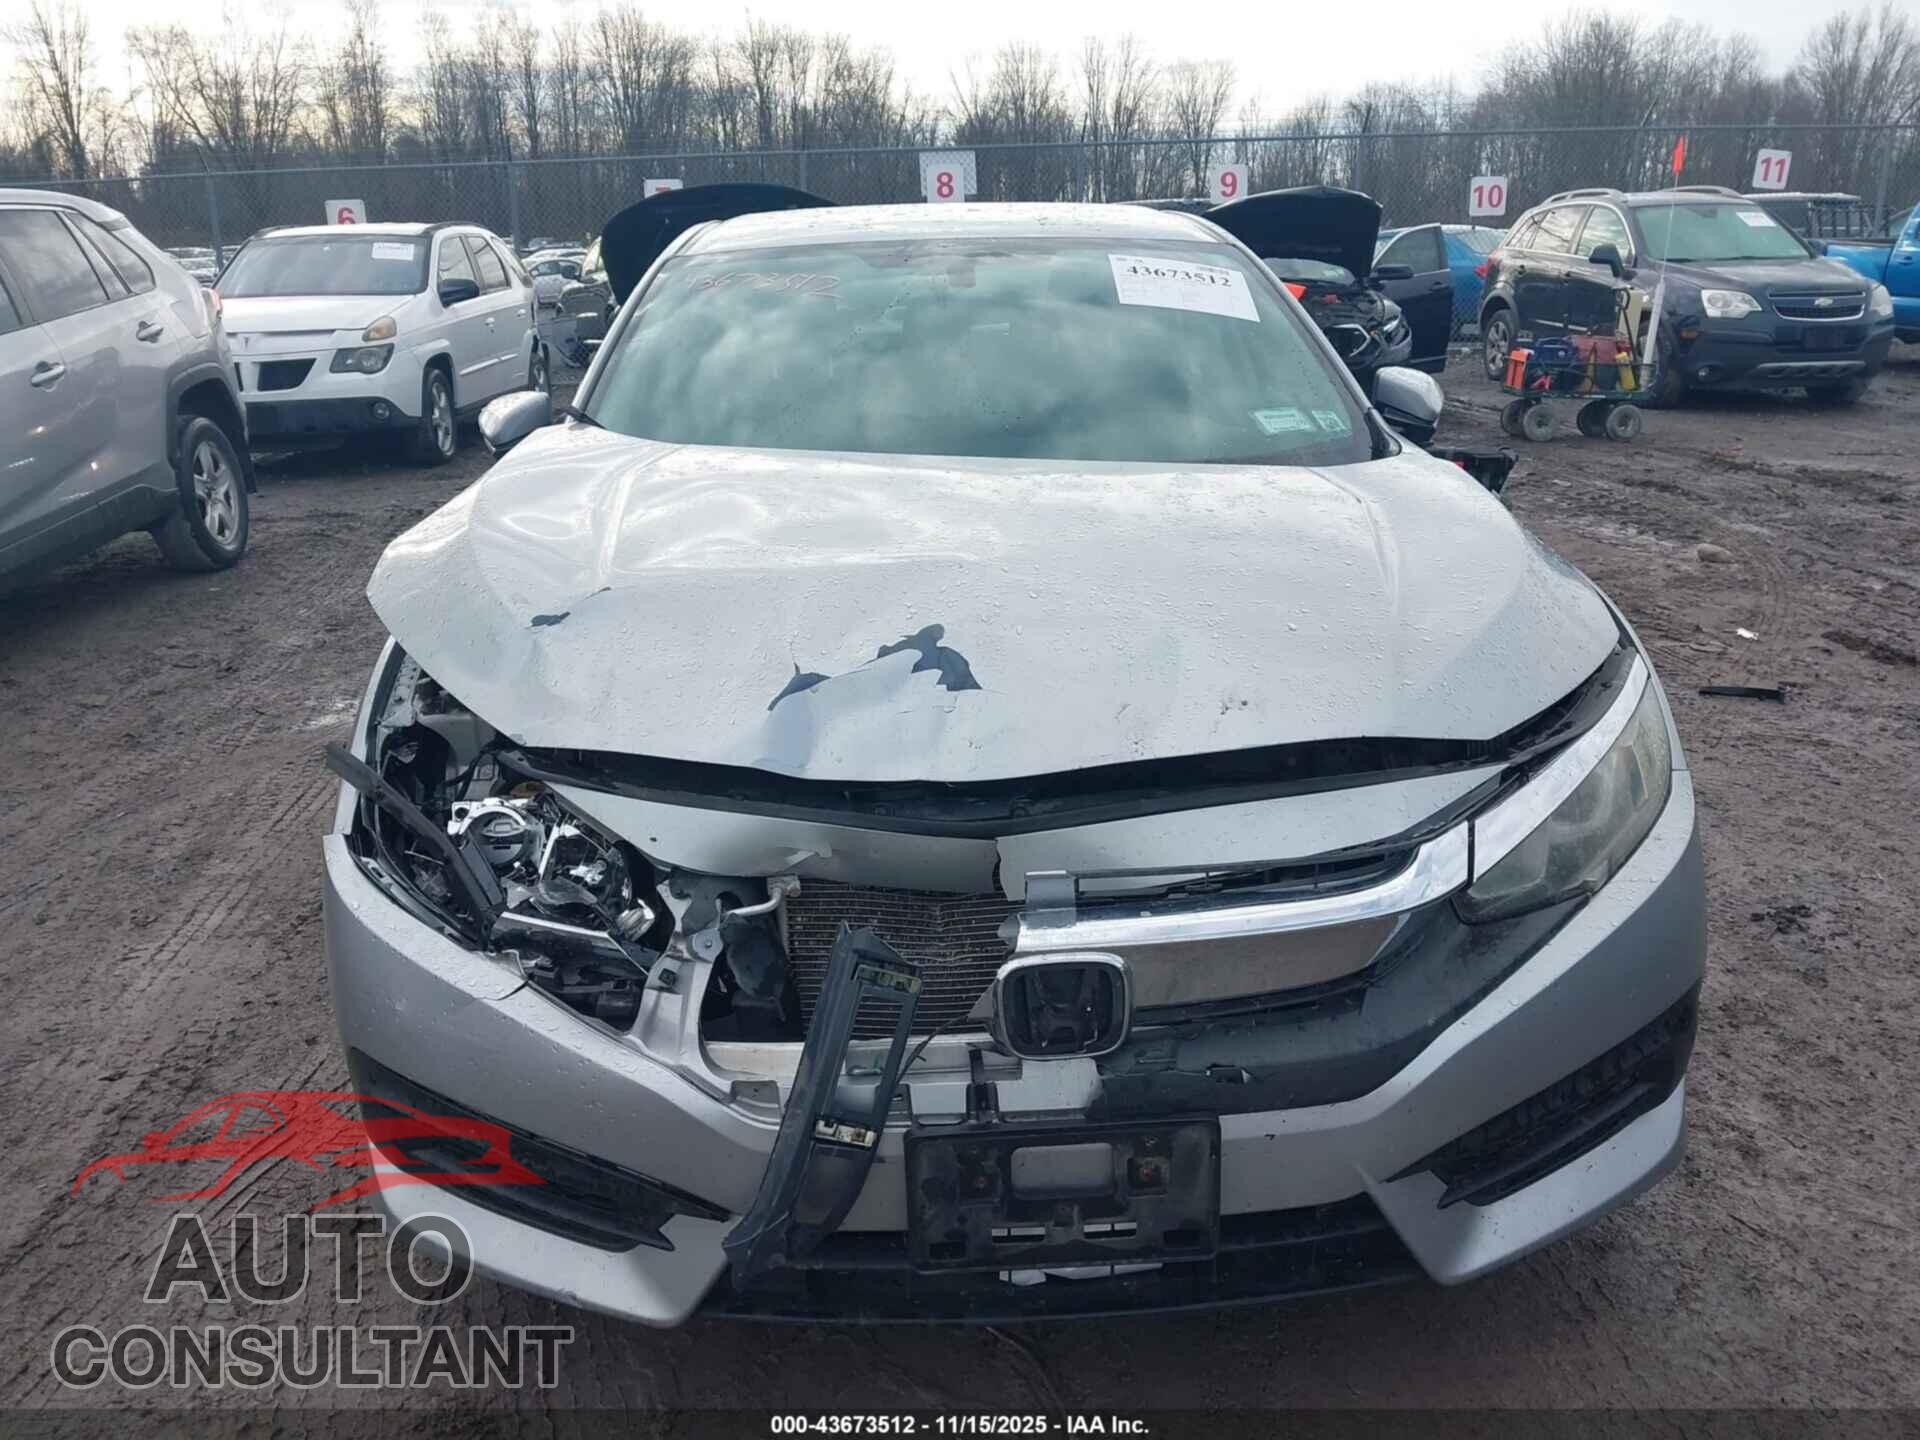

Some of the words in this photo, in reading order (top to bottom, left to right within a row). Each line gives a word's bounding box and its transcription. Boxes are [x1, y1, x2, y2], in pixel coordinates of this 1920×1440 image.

[1761, 156, 1785, 182] 11
[937, 172, 954, 198] 8
[1220, 172, 1237, 198] 9
[1473, 184, 1503, 208] 10
[338, 207, 356, 225] 6
[1127, 264, 1232, 288] 43673512
